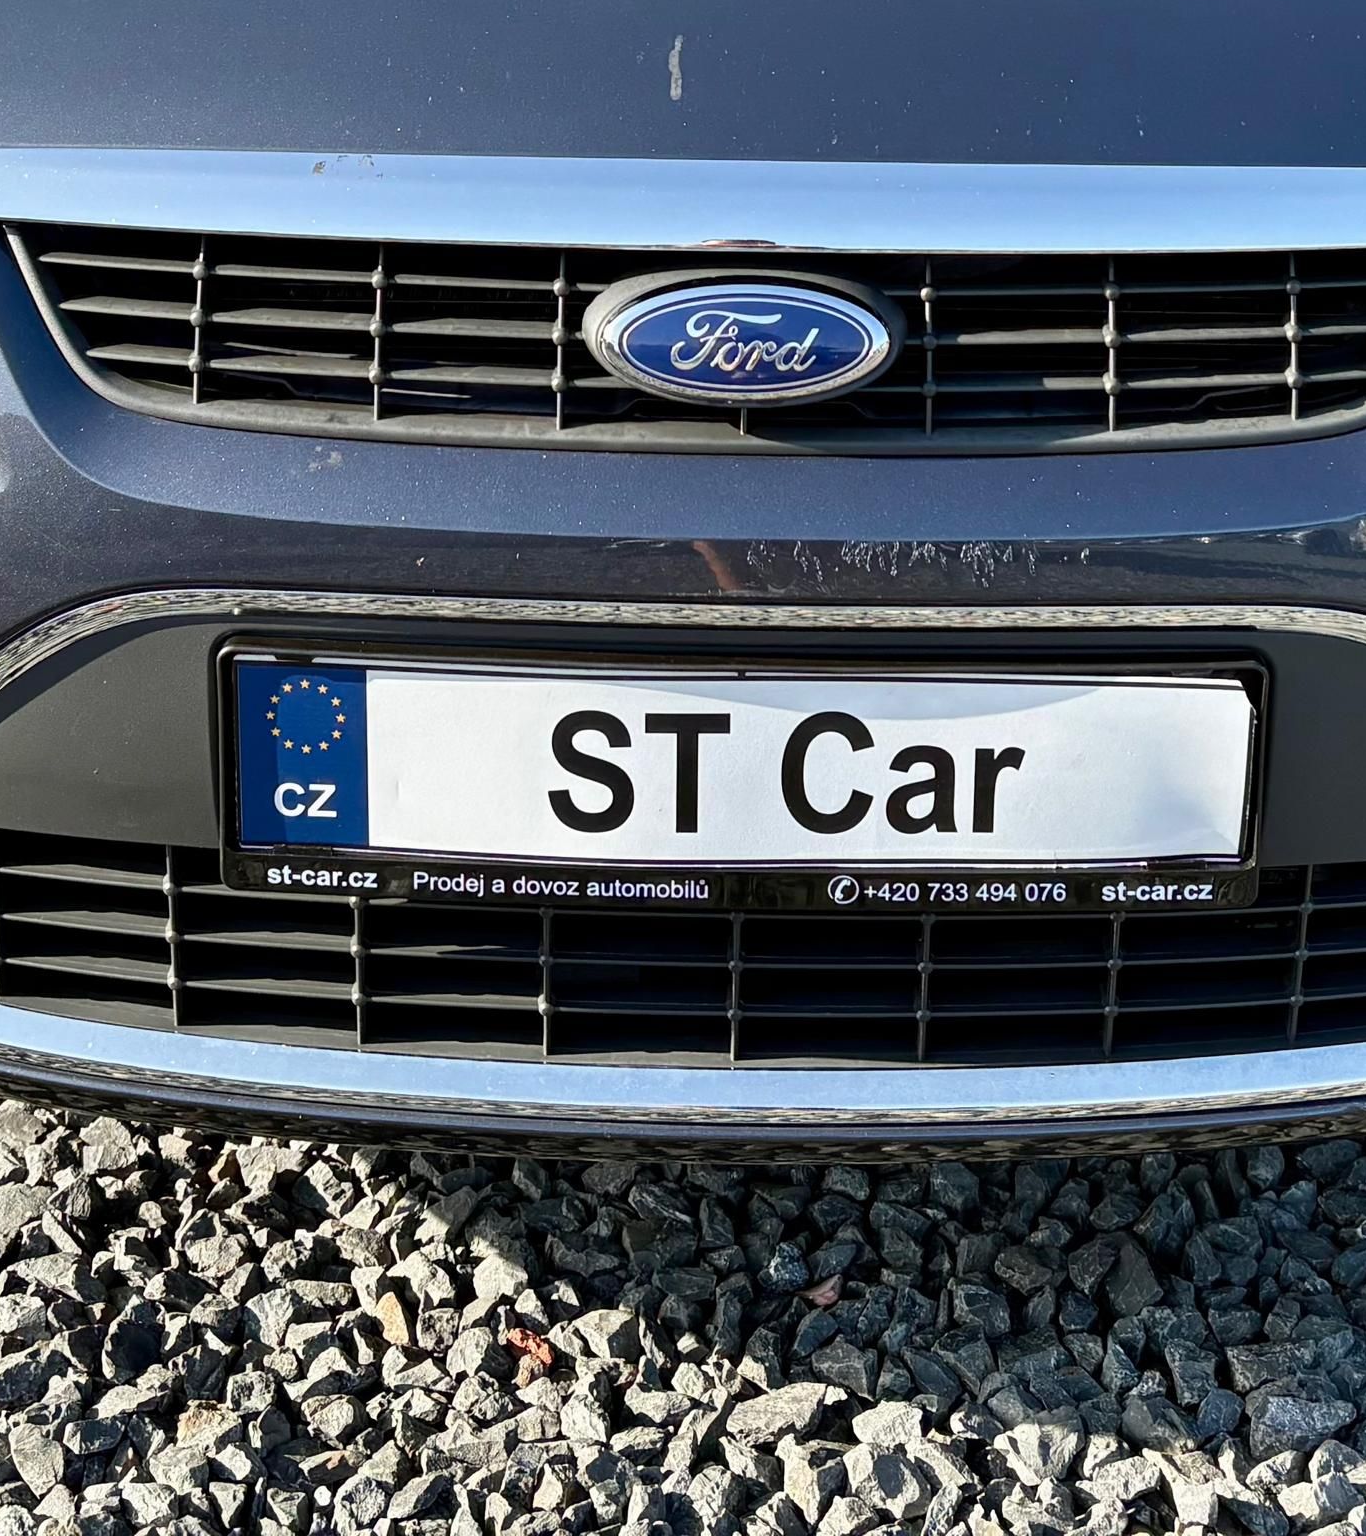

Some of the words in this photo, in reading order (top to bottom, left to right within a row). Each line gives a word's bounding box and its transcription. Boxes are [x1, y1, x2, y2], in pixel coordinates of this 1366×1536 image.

[670, 310, 821, 371] Ford
[546, 709, 732, 835] ST
[780, 710, 1027, 836] Car
[273, 781, 338, 818] CZ
[266, 864, 379, 889] st-car.cz
[412, 870, 485, 899] Prodej
[490, 877, 506, 895] a
[511, 874, 581, 897] dovoz
[585, 878, 710, 900] automobilů
[1100, 880, 1214, 903] st-car.cz
[862, 881, 921, 903] +420
[926, 881, 970, 903] 733
[974, 882, 1018, 903] 494
[1023, 881, 1068, 903] 076
